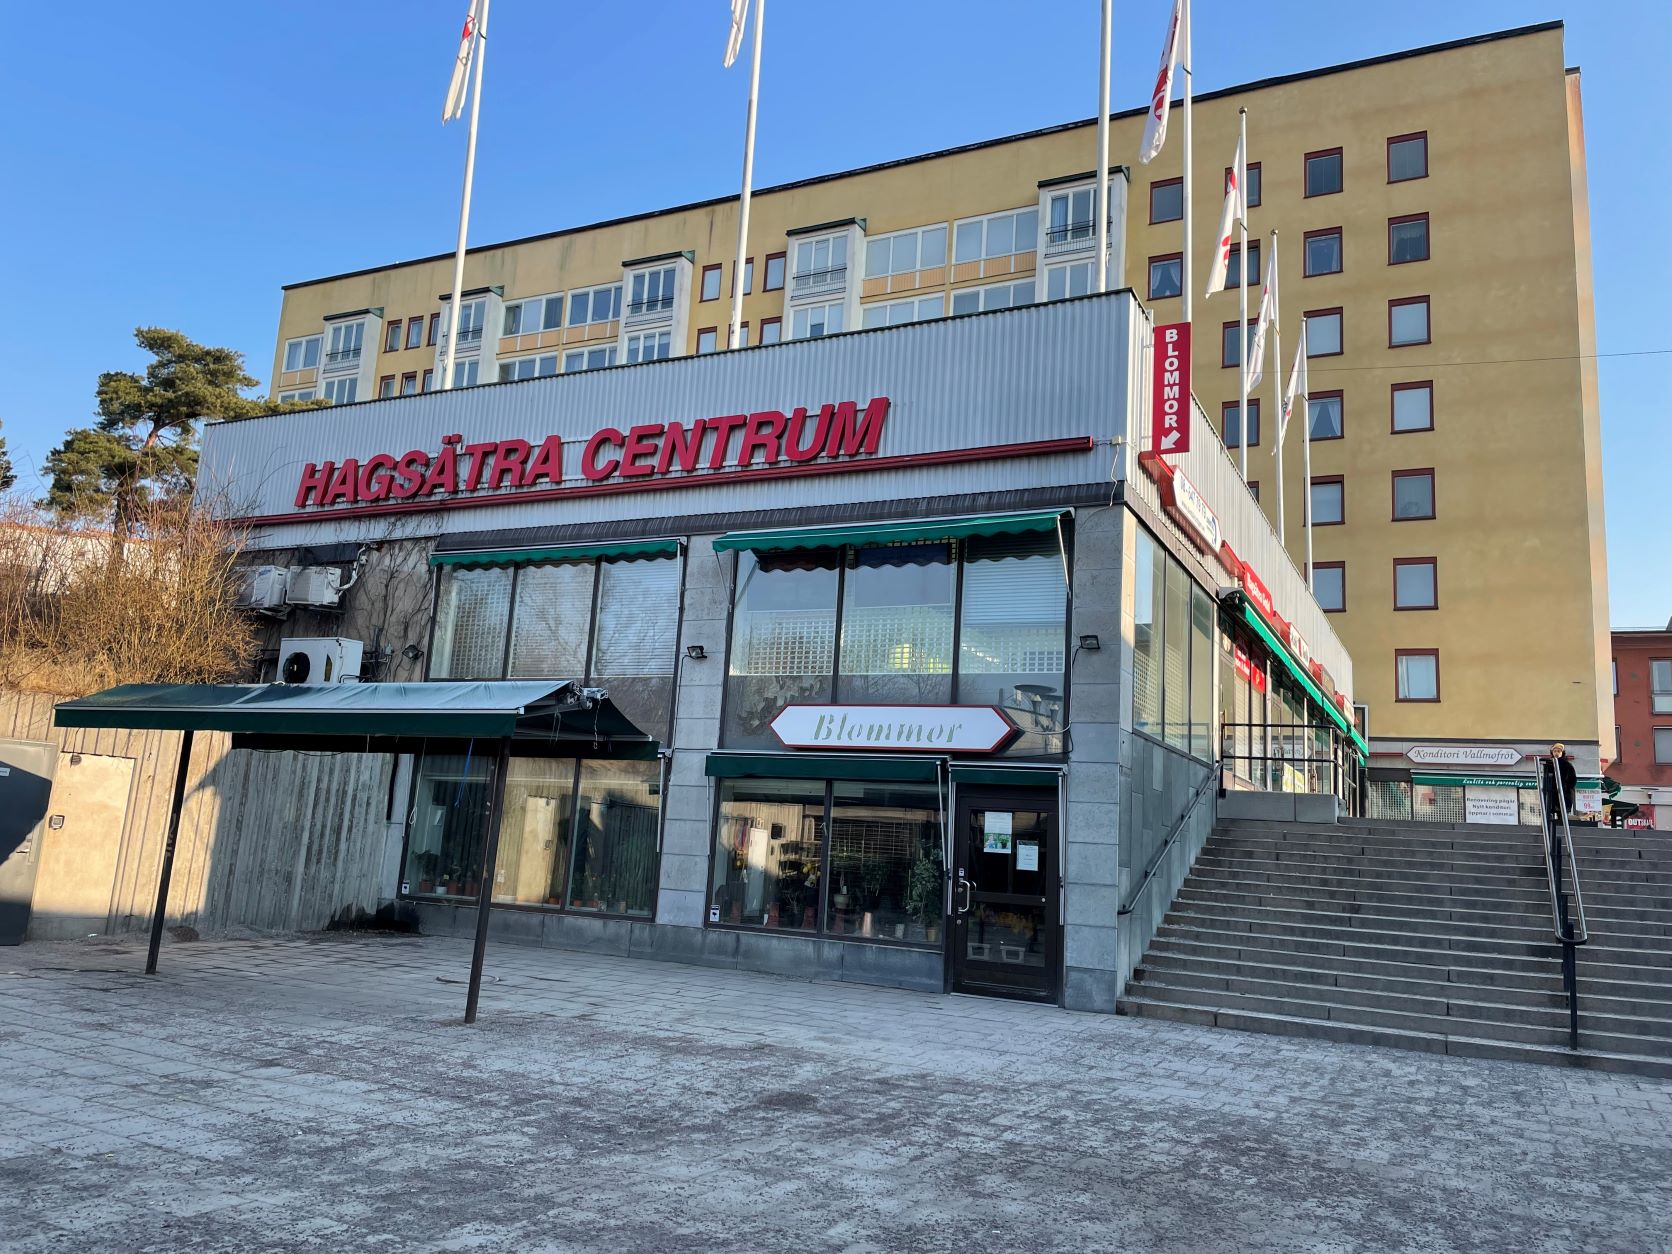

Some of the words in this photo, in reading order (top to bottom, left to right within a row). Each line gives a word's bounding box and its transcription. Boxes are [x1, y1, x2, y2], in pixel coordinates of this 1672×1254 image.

[1163, 328, 1180, 429] BLOMMOR
[295, 433, 563, 507] HAGSÄTRA
[581, 396, 890, 480] CENTRUM
[812, 711, 962, 743] Blommor
[1414, 748, 1460, 760] Konditori
